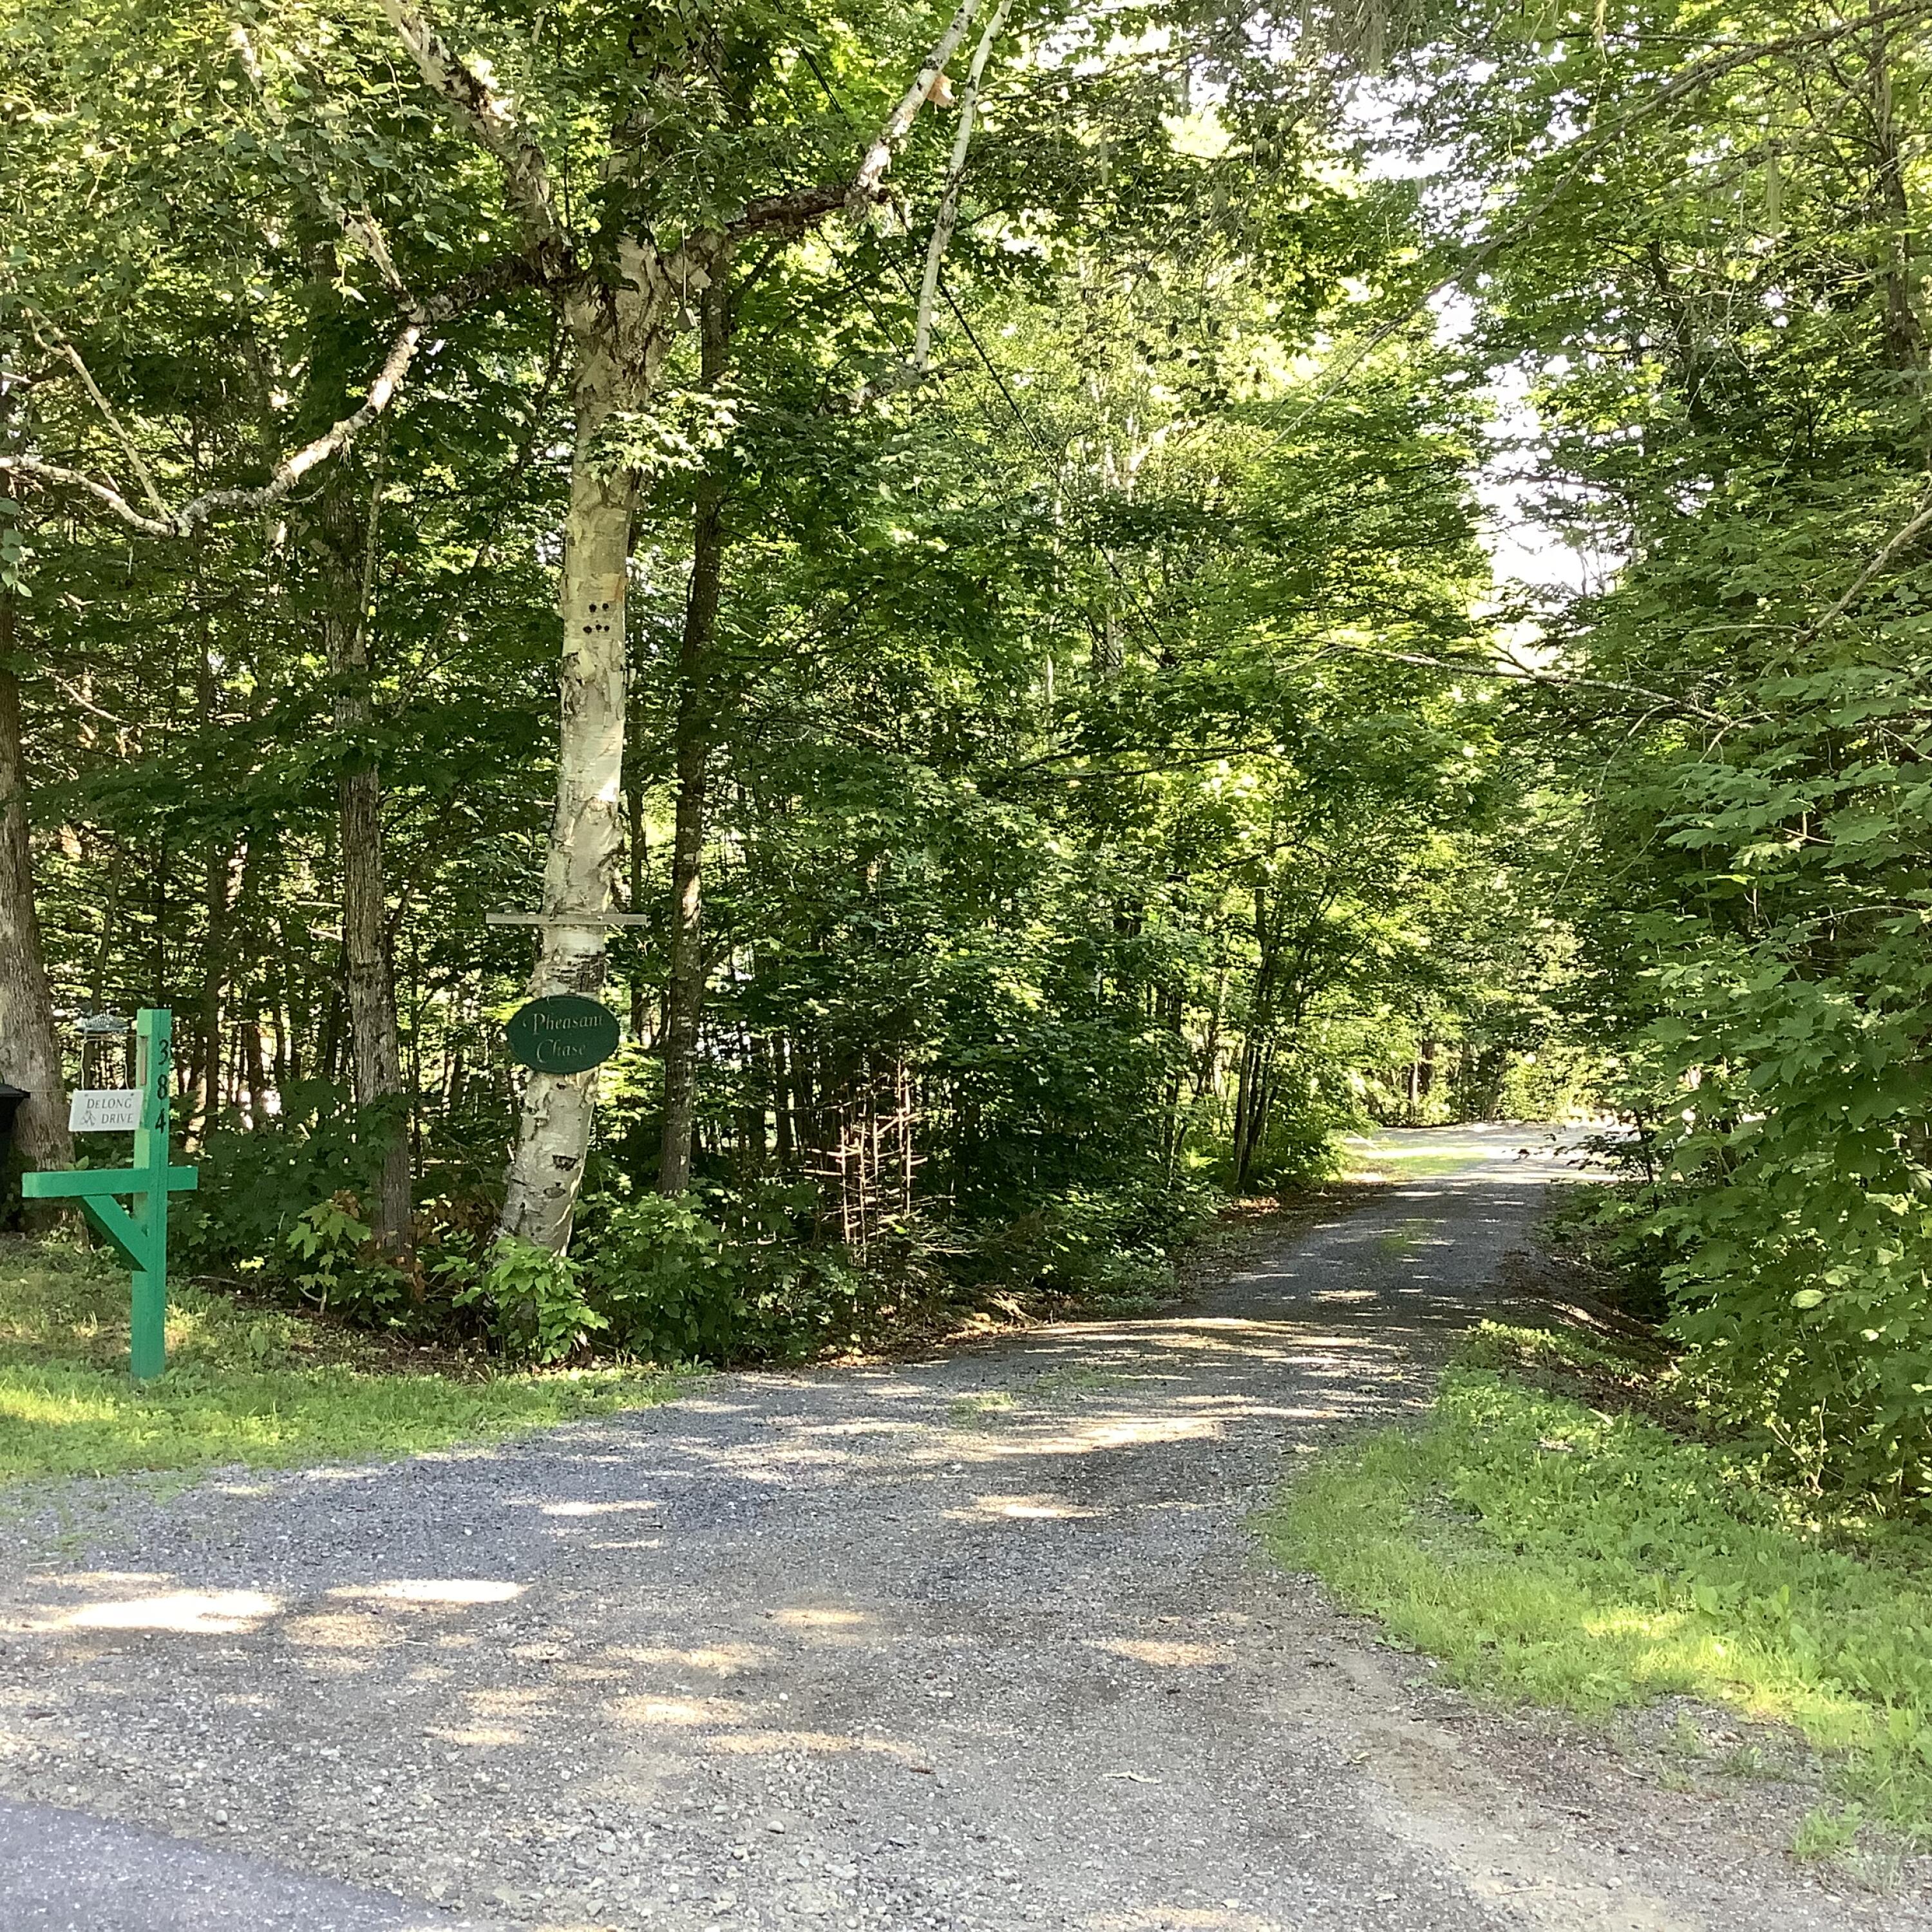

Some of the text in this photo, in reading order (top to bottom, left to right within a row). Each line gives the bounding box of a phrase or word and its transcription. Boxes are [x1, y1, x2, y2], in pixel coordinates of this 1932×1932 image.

[522, 1013, 603, 1036] Pheasant
[536, 1039, 587, 1063] Chase
[155, 1039, 169, 1134] 384
[101, 1113, 134, 1124] DRIVE
